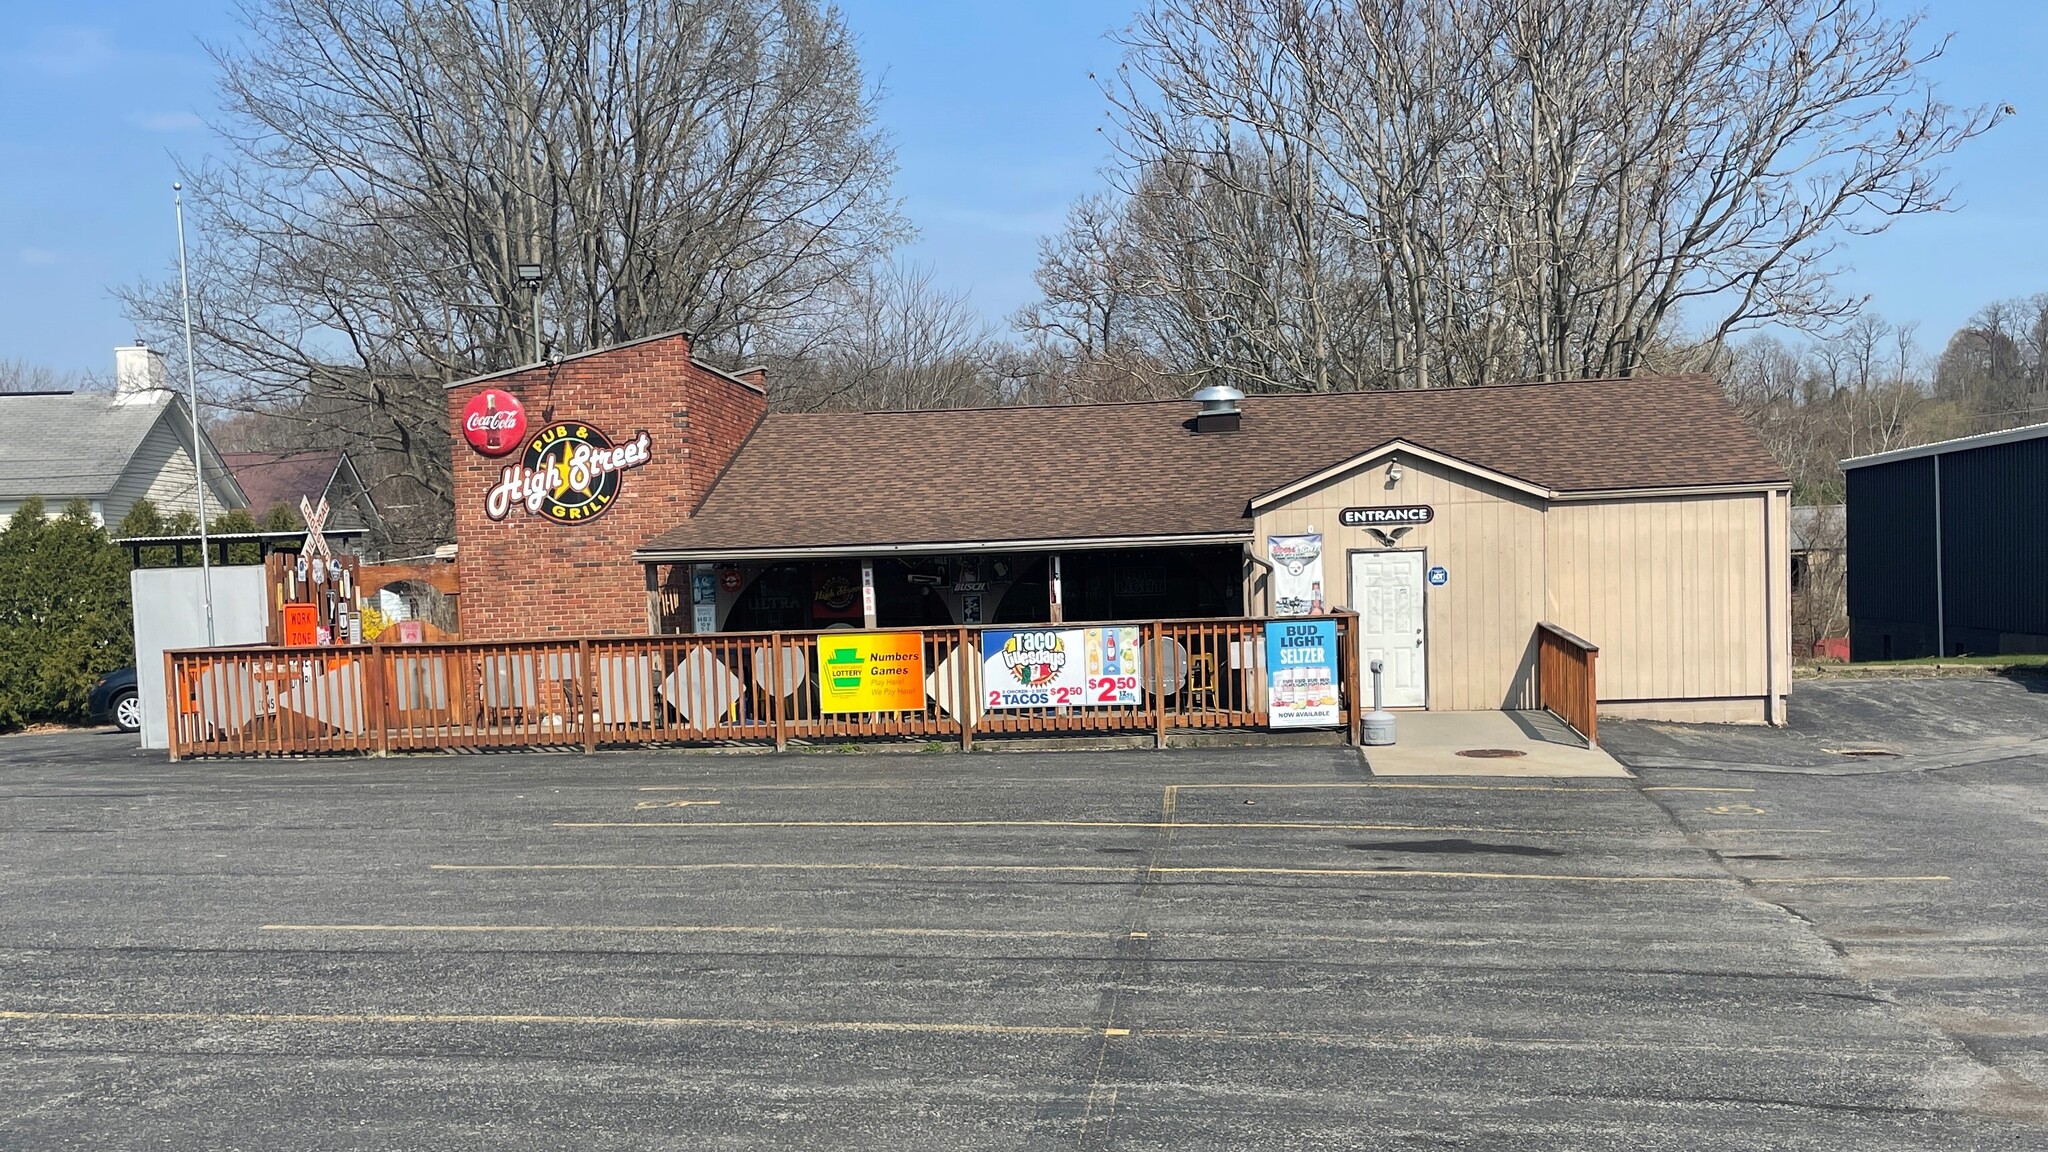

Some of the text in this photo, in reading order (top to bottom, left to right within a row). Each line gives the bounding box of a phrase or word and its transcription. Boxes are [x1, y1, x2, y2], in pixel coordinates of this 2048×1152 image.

[532, 425, 589, 453] PUB &
[487, 434, 650, 516] High Street
[552, 494, 611, 519] GRILL
[1345, 509, 1428, 522] ENTRANCE
[954, 582, 986, 591] BUSCH
[748, 597, 801, 610] ULTRA
[290, 613, 311, 625] WORK
[1286, 625, 1317, 637] BUD
[292, 632, 311, 645] ZONE
[1280, 636, 1324, 648] LIGHT
[870, 652, 919, 662] Numbers
[1280, 648, 1325, 664] SELTZER
[871, 667, 908, 676] Games
[871, 679, 884, 687] Play
[872, 688, 882, 696] We
[884, 688, 896, 697] Pay
[989, 690, 1001, 705] 2
[1002, 694, 1049, 705] TACOS
